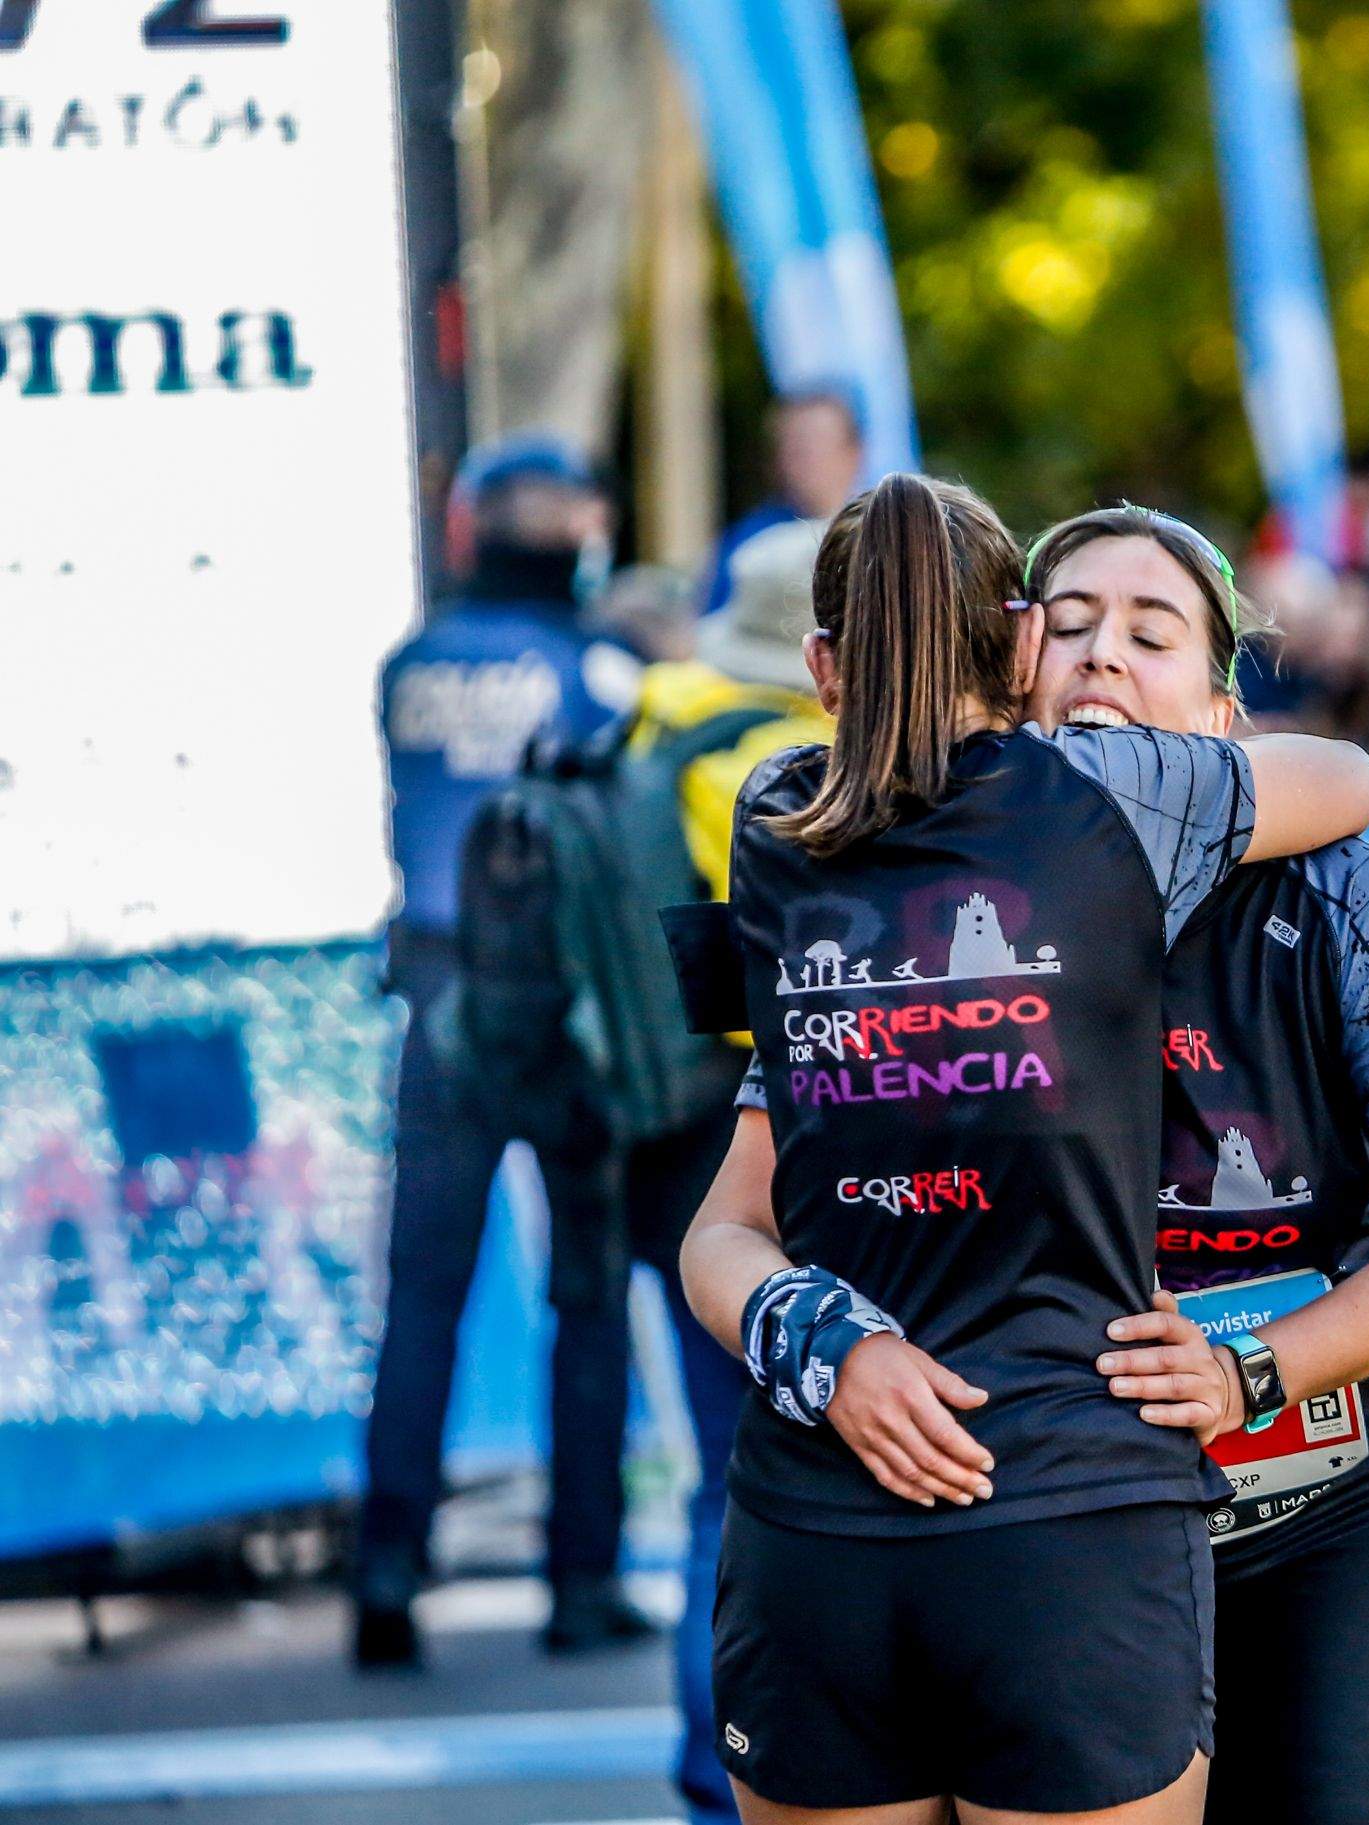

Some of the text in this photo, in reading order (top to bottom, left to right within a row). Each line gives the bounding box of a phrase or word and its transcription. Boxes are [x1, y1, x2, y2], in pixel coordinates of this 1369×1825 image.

[0, 308, 315, 396] ma
[784, 995, 1050, 1060] CORRIENDO
[789, 1044, 813, 1062] POR
[790, 1052, 1053, 1107] PALENCIA
[1190, 1310, 1272, 1338] ovistar
